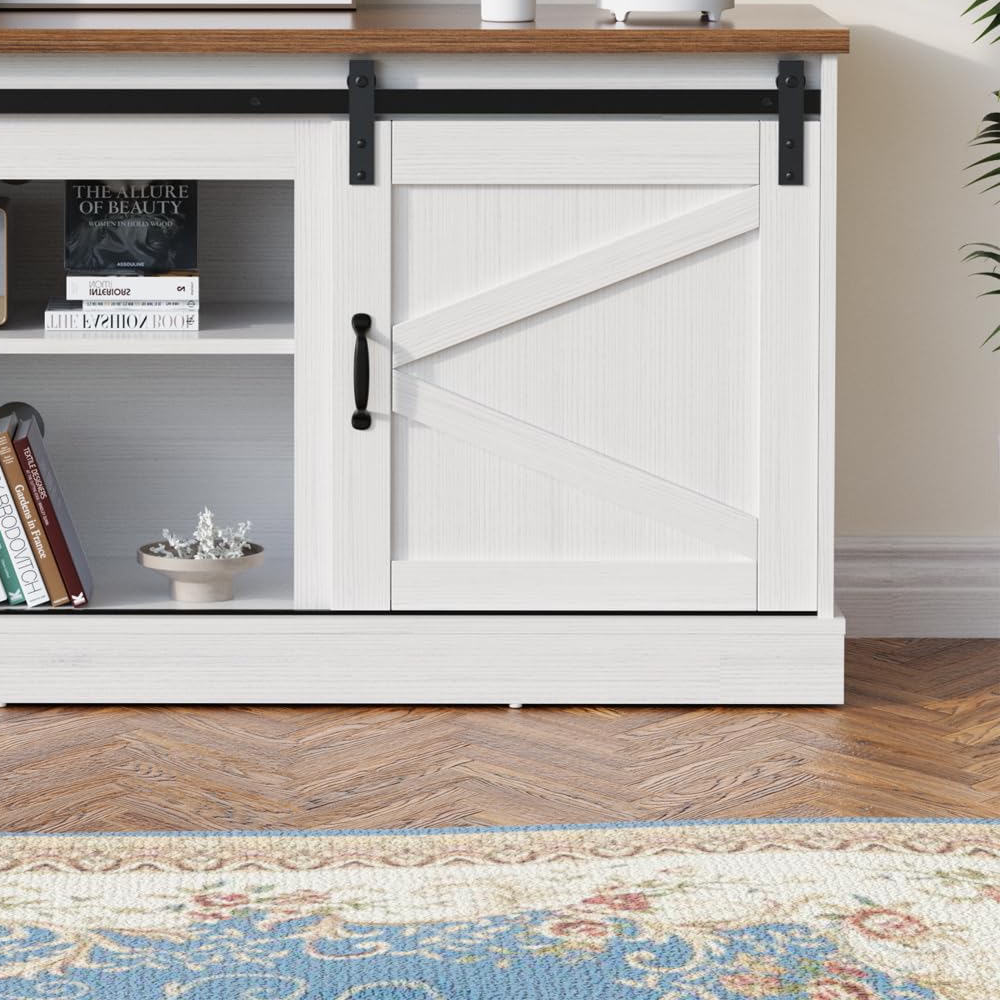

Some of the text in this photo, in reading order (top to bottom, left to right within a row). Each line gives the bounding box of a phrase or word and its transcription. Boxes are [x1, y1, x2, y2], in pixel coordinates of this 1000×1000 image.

[73, 185, 189, 199] THE ALLURE
[79, 201, 182, 215] OF BEAUTY
[23, 447, 36, 470] TEXTILE
[30, 468, 47, 500] DESIGNERS
[14, 484, 33, 520] Gardens
[27, 519, 36, 530] in
[31, 528, 47, 559] France
